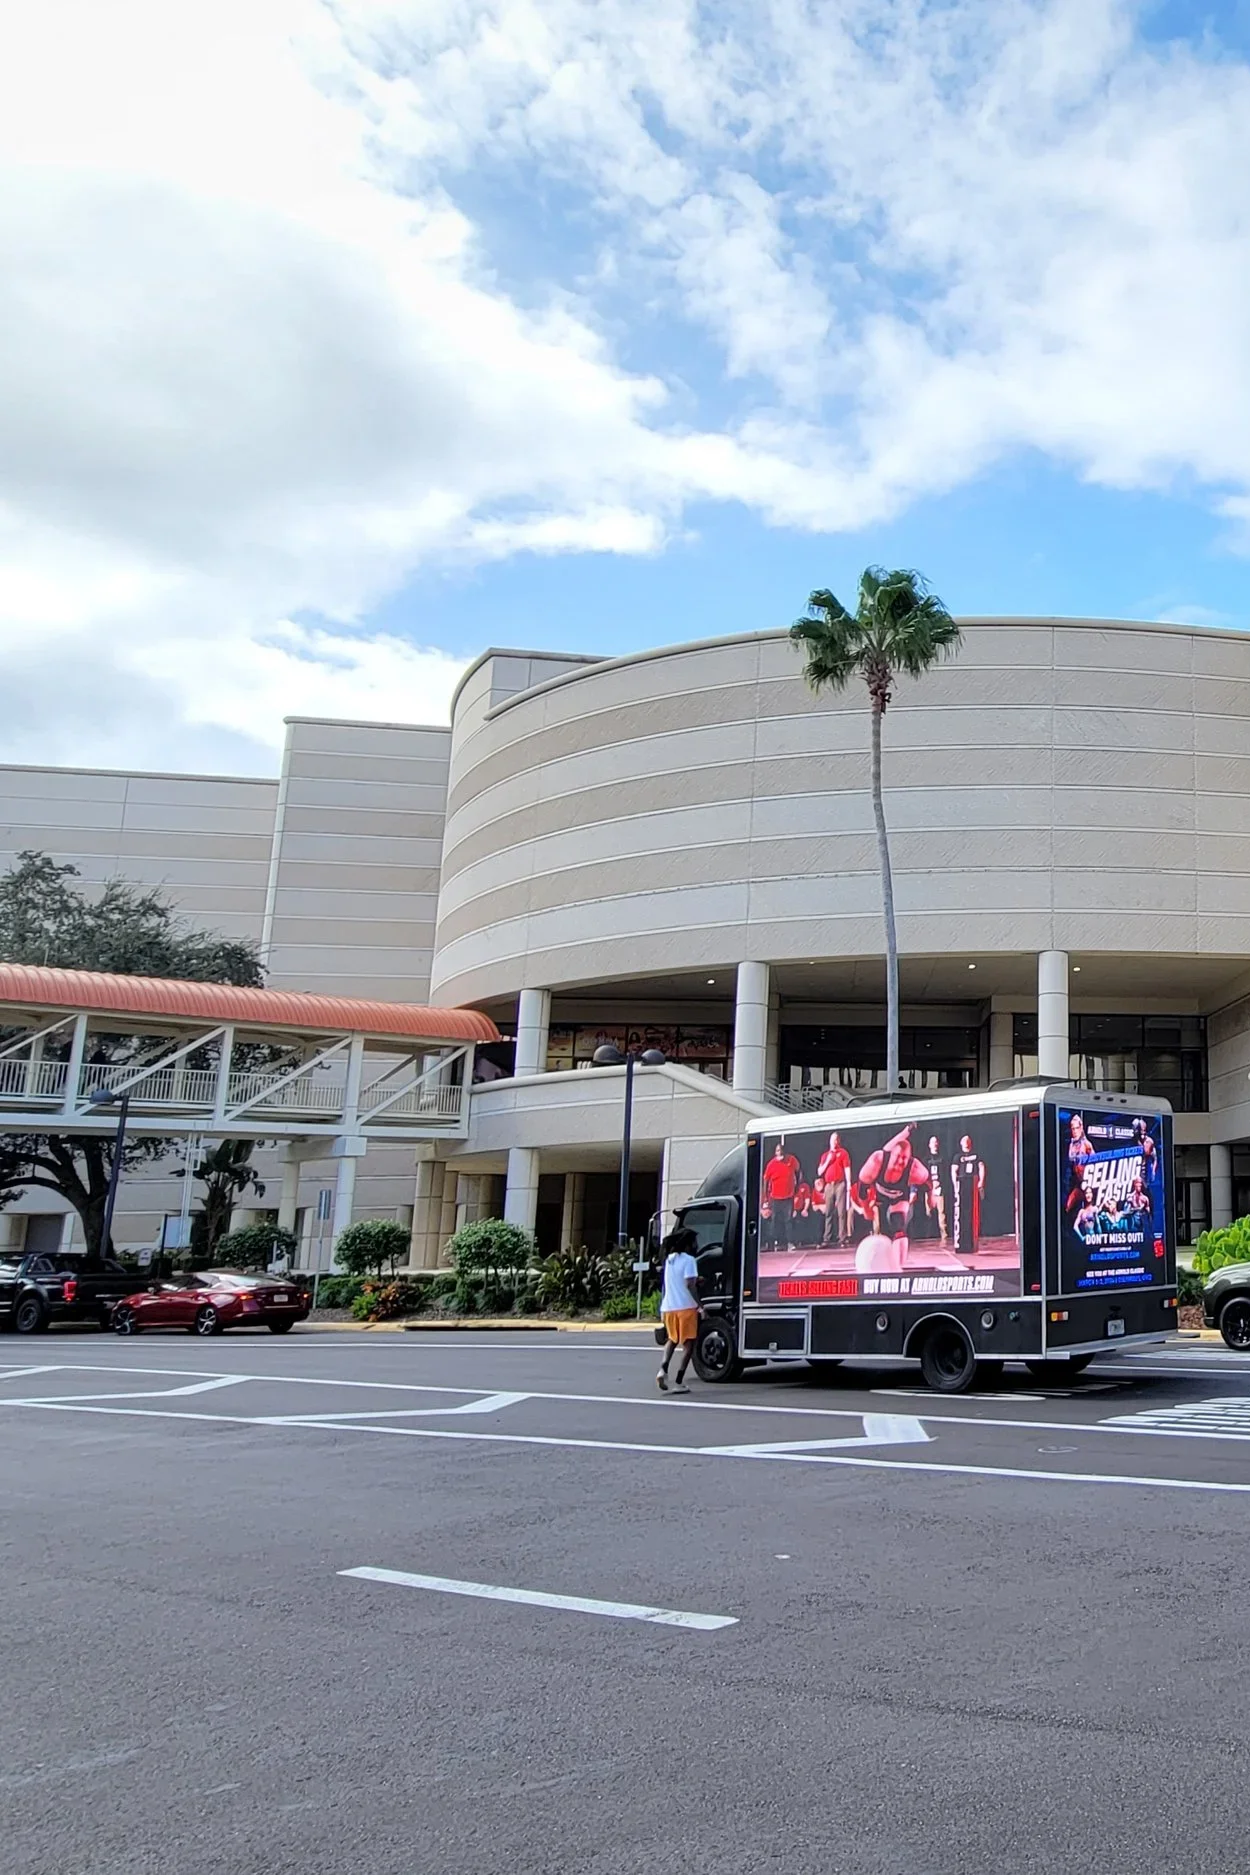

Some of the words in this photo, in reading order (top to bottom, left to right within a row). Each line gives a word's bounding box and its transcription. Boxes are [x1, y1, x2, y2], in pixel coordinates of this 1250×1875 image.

[1081, 1156, 1142, 1190] SELLING
[1096, 1179, 1133, 1207] FAST!
[1086, 1233, 1108, 1245] DON'T
[1109, 1232, 1127, 1244] MISS
[1127, 1232, 1144, 1243] OUT!
[863, 1279, 879, 1294] BUY
[880, 1279, 899, 1293] NOW
[900, 1278, 910, 1293] AT
[911, 1275, 994, 1293] ARNOLDSPORTS.COM
